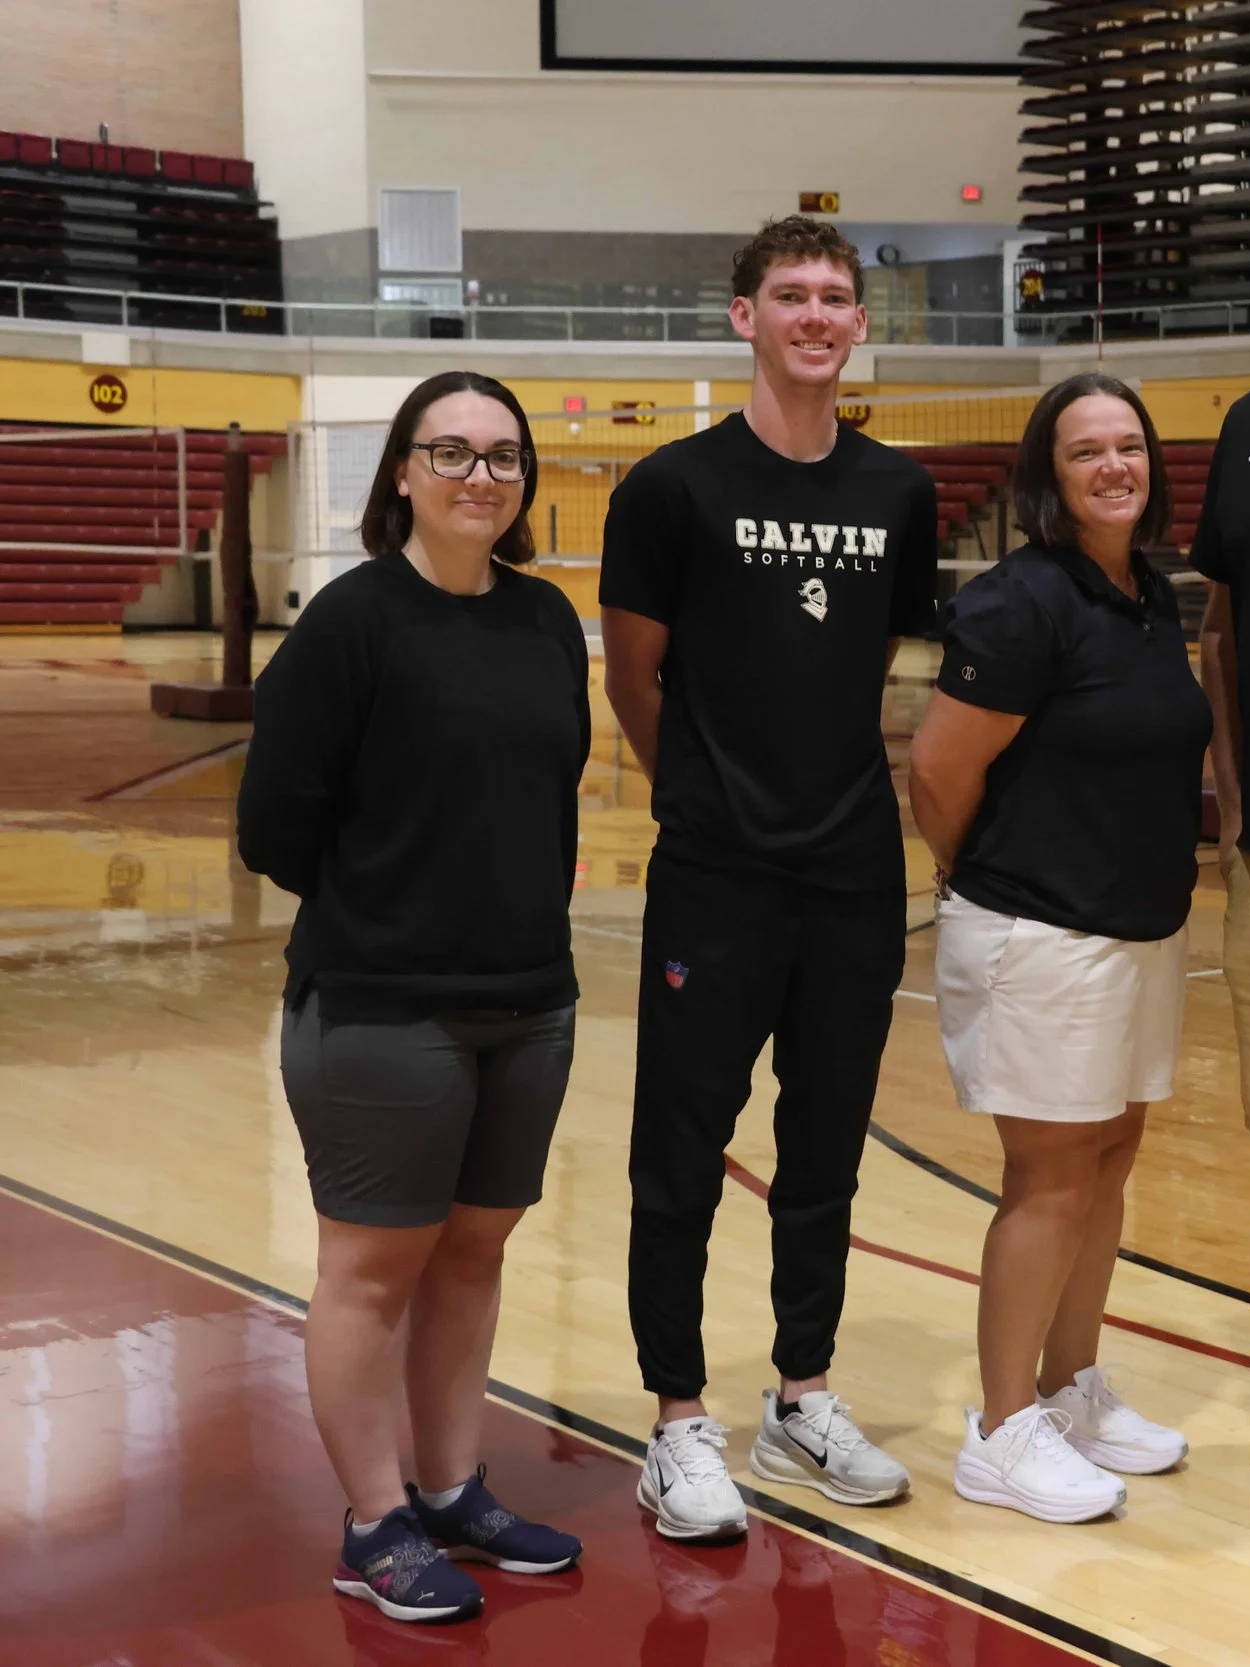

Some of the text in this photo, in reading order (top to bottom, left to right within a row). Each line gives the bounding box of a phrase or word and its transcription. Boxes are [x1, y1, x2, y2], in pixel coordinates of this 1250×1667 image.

[93, 384, 123, 404] 102
[735, 518, 888, 557] CALVIN
[743, 552, 877, 572] SOFTBALL
